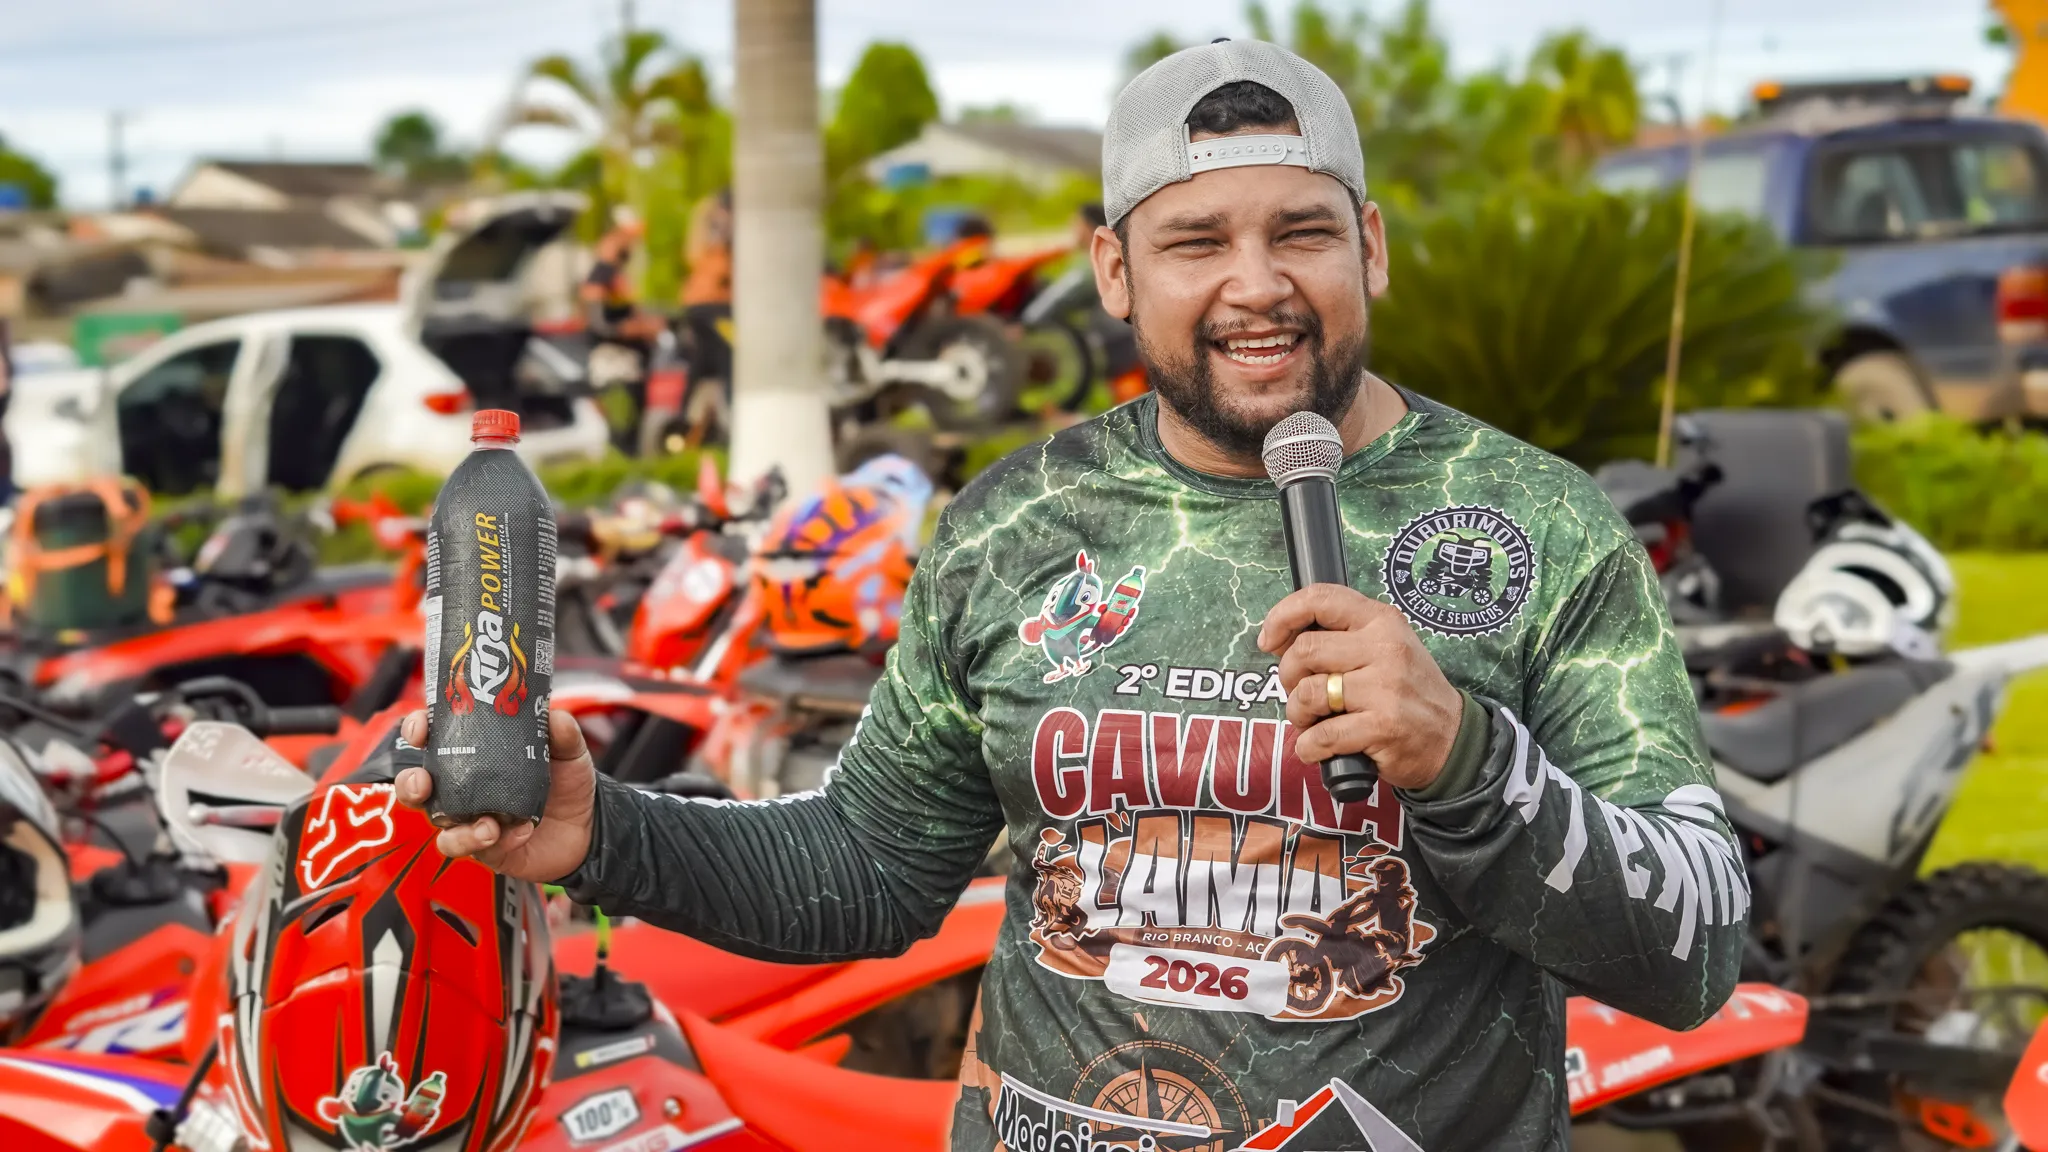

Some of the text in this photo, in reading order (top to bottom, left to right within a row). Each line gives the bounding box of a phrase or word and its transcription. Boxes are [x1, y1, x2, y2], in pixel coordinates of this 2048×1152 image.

[476, 512, 501, 612] POWER
[1395, 513, 1526, 580] QUADRIMOTOS
[1403, 588, 1504, 625] PEÇAS E SERVIÇOS
[1164, 664, 1288, 711] EDIÇÃ
[451, 746, 476, 754] GELADO
[525, 744, 536, 760] 1L
[1075, 808, 1348, 936] LAMA
[1142, 932, 1169, 942] RIO
[1172, 933, 1233, 948] BRANCO
[1245, 943, 1266, 954] AC
[1139, 954, 1251, 1001] 2026
[990, 1083, 1157, 1152] Madei
